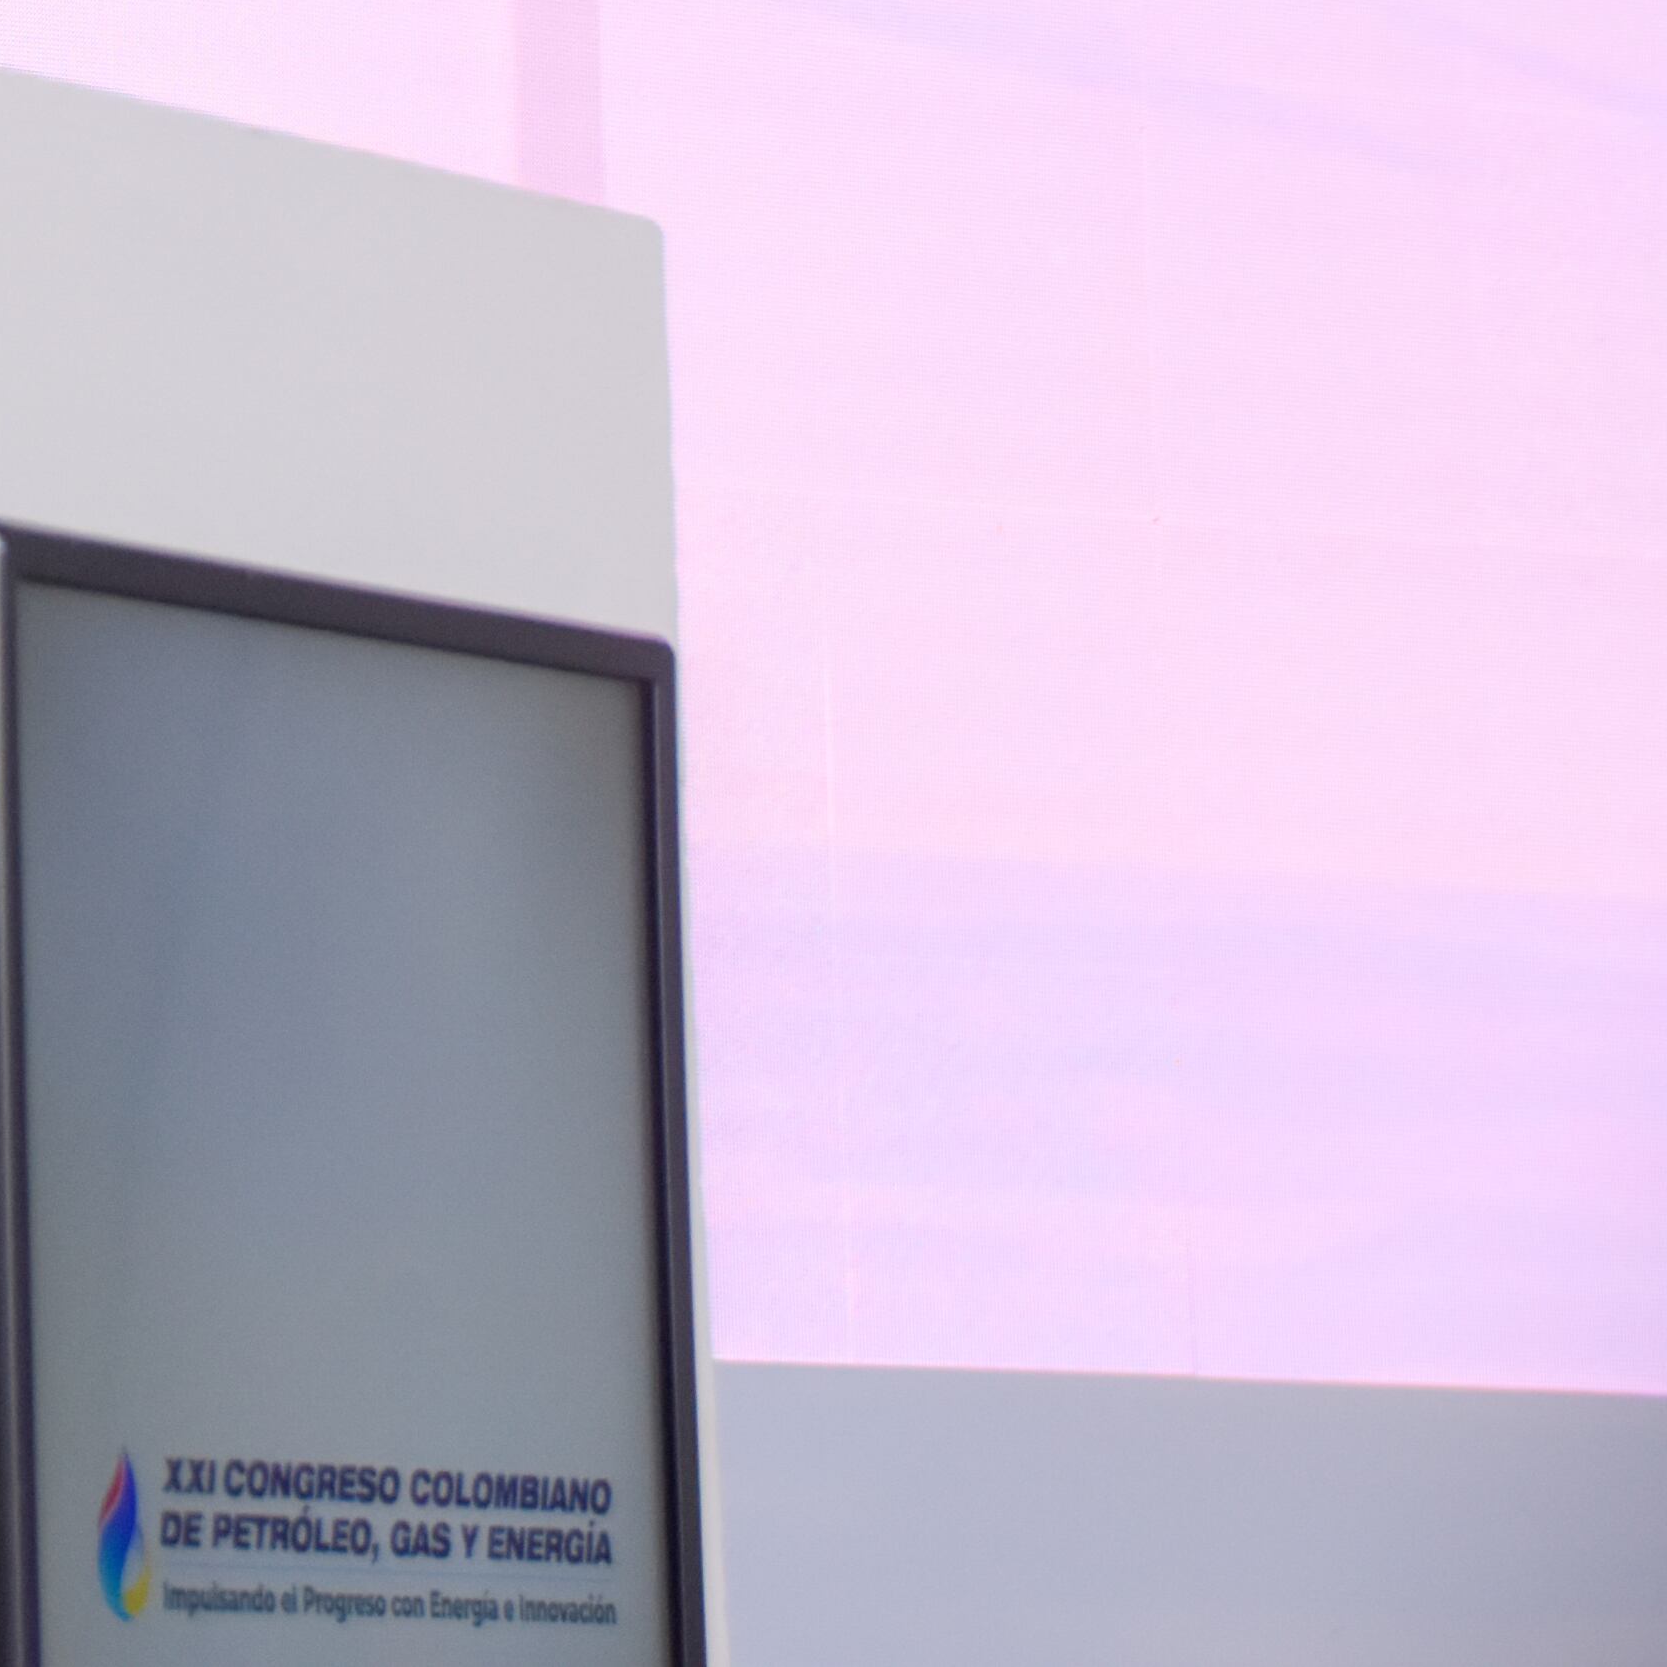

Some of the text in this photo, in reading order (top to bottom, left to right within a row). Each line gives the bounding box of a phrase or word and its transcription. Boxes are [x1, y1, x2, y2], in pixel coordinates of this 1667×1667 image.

[163, 1457, 613, 1515] XXI CONGRESO COLOMBIANO
[160, 1504, 612, 1565] DE PETRÓLEO, GAS Y ENERGÍA
[163, 1582, 616, 1628] Impulsando el Progreso con Energía e Innovación
